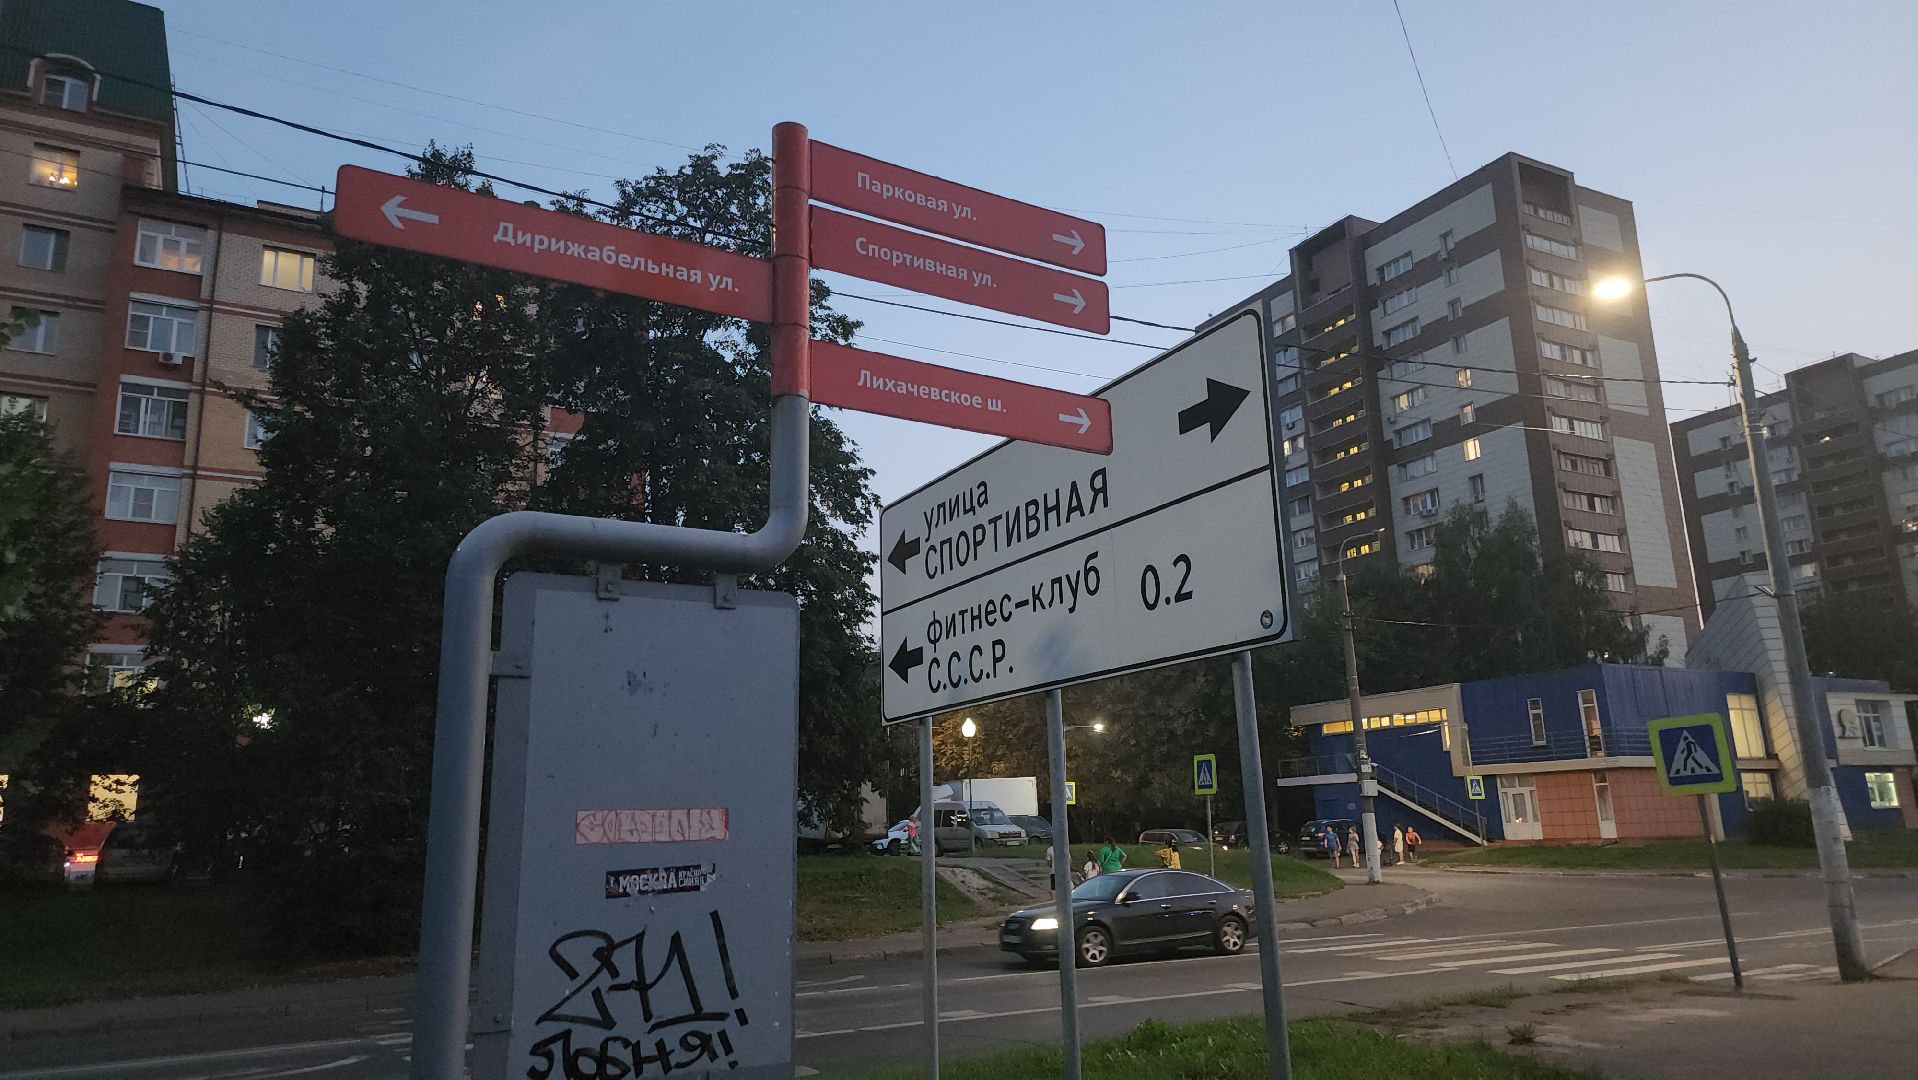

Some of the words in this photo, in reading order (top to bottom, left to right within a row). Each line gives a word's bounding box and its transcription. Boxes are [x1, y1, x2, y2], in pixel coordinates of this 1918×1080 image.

[857, 171, 948, 212] Парковая
[951, 202, 977, 221] ул.
[493, 221, 702, 284] Дирижабельная
[706, 271, 740, 293] ул.
[855, 237, 967, 281] Спортивная
[971, 269, 997, 288] ул.
[857, 369, 982, 408] Лихачевское
[986, 397, 1006, 412] ш.
[923, 480, 989, 543] улица
[924, 466, 1109, 580] СПОРТИВНАЯ
[927, 551, 1100, 653] фитнес-клуб
[1140, 553, 1193, 611] 0.2
